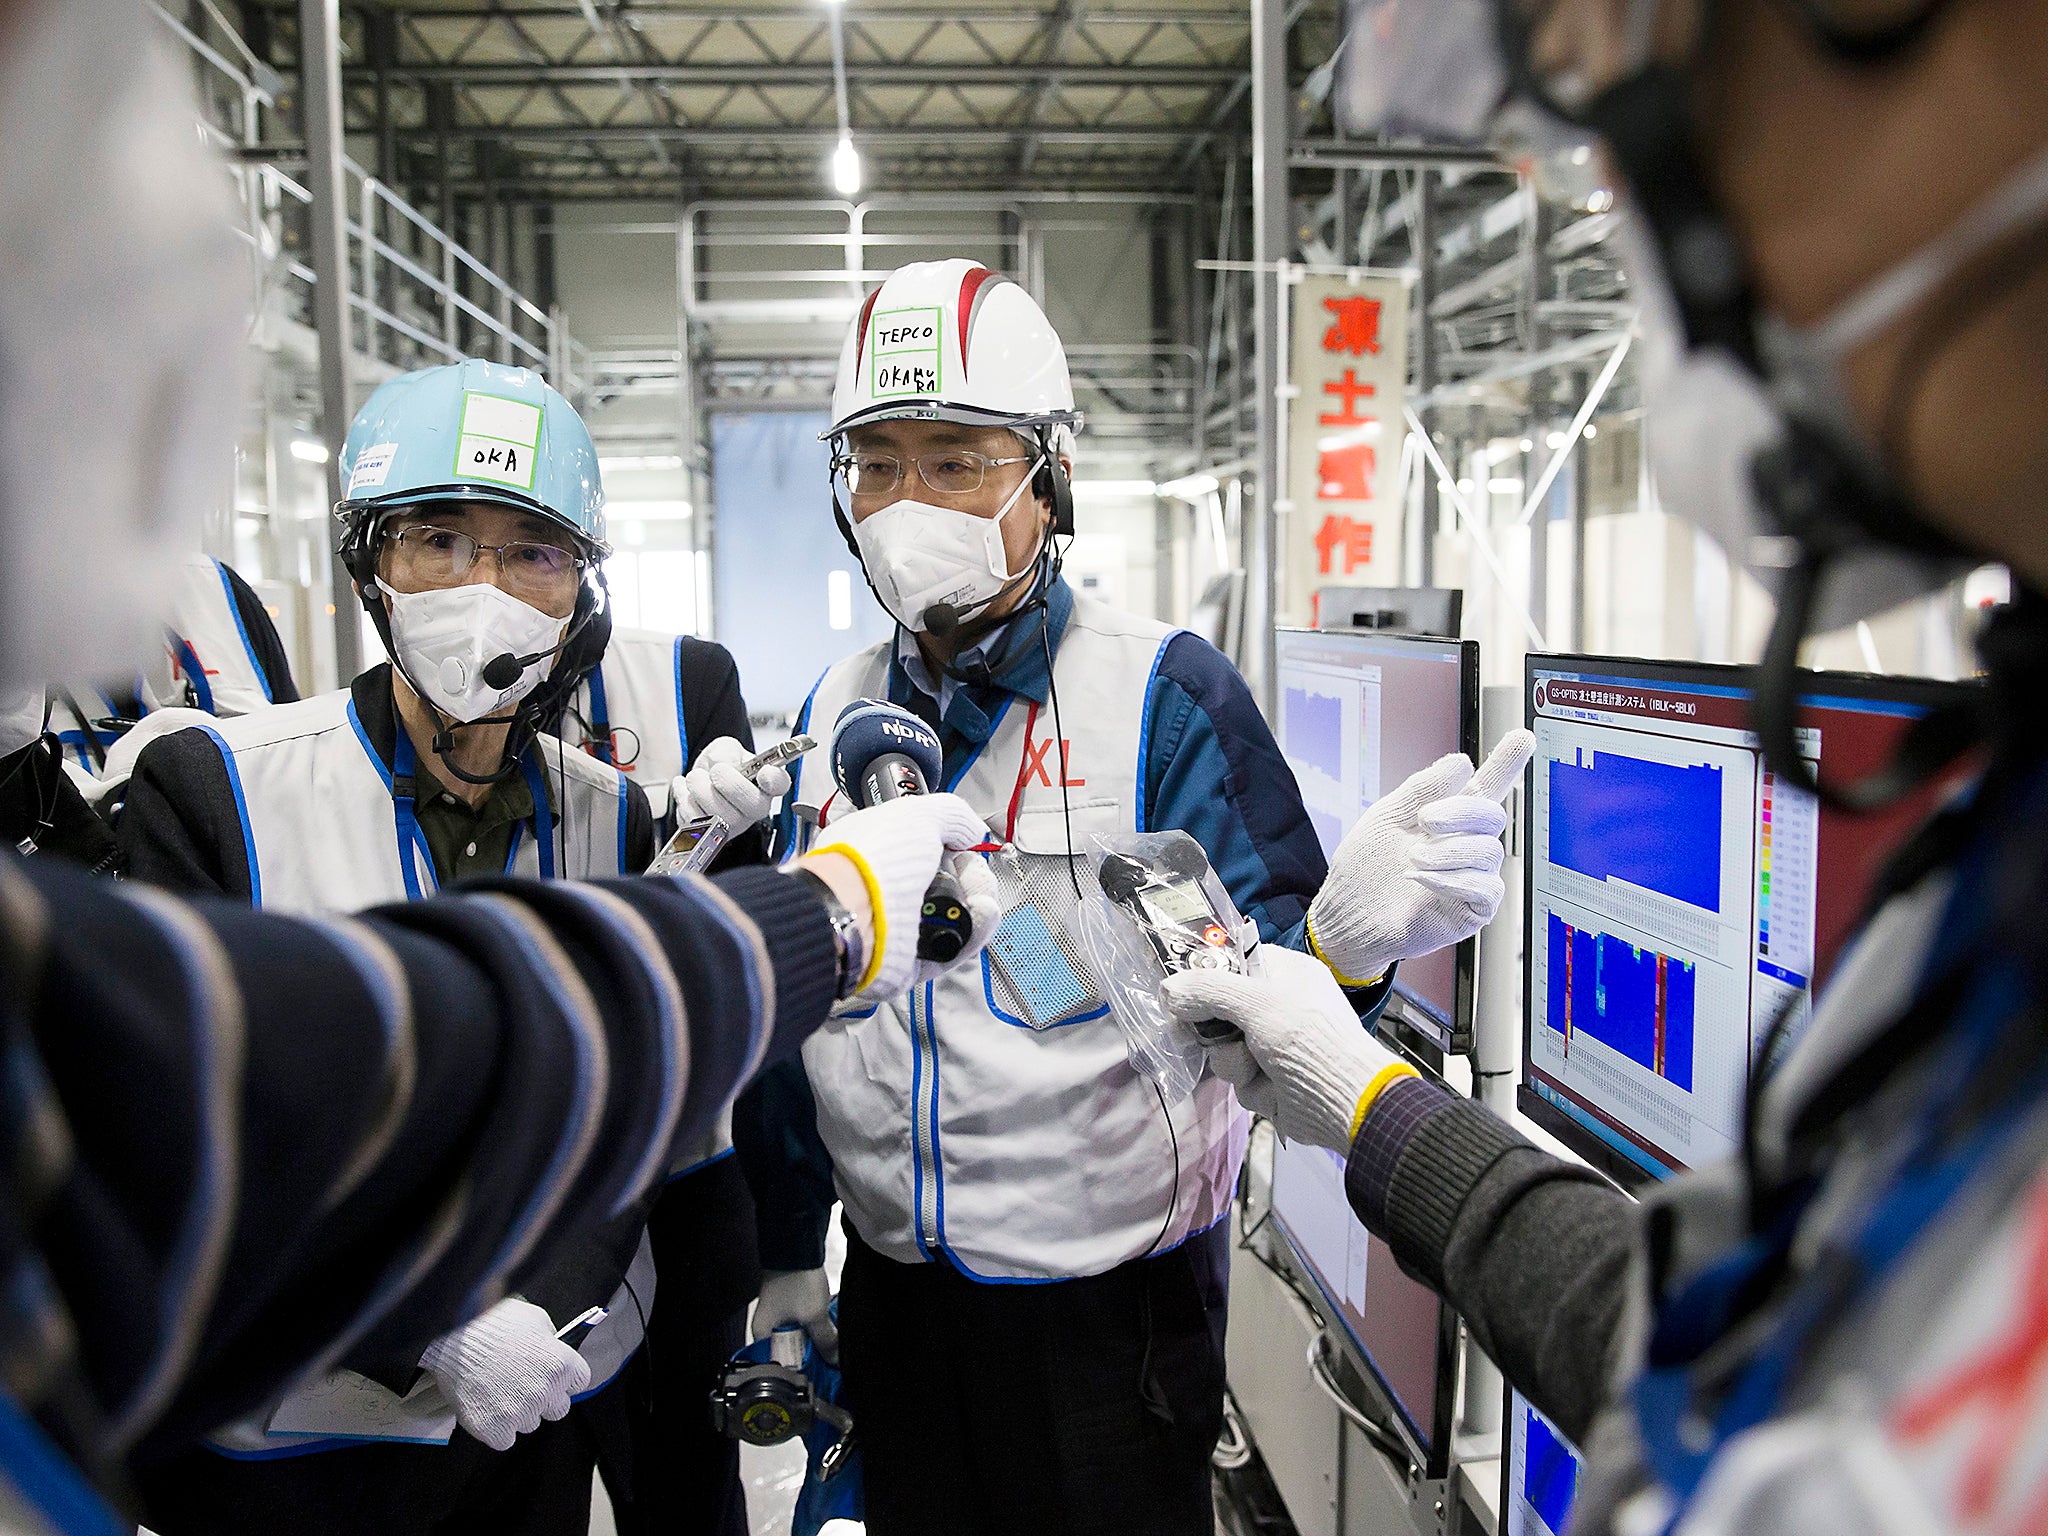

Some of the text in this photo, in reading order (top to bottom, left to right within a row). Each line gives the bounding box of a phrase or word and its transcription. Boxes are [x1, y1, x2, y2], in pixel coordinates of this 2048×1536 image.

[879, 327, 933, 346] TEPCO
[473, 448, 517, 472] OKA
[1551, 688, 1578, 701] GS-OPTIS
[1021, 738, 1085, 787] XL
